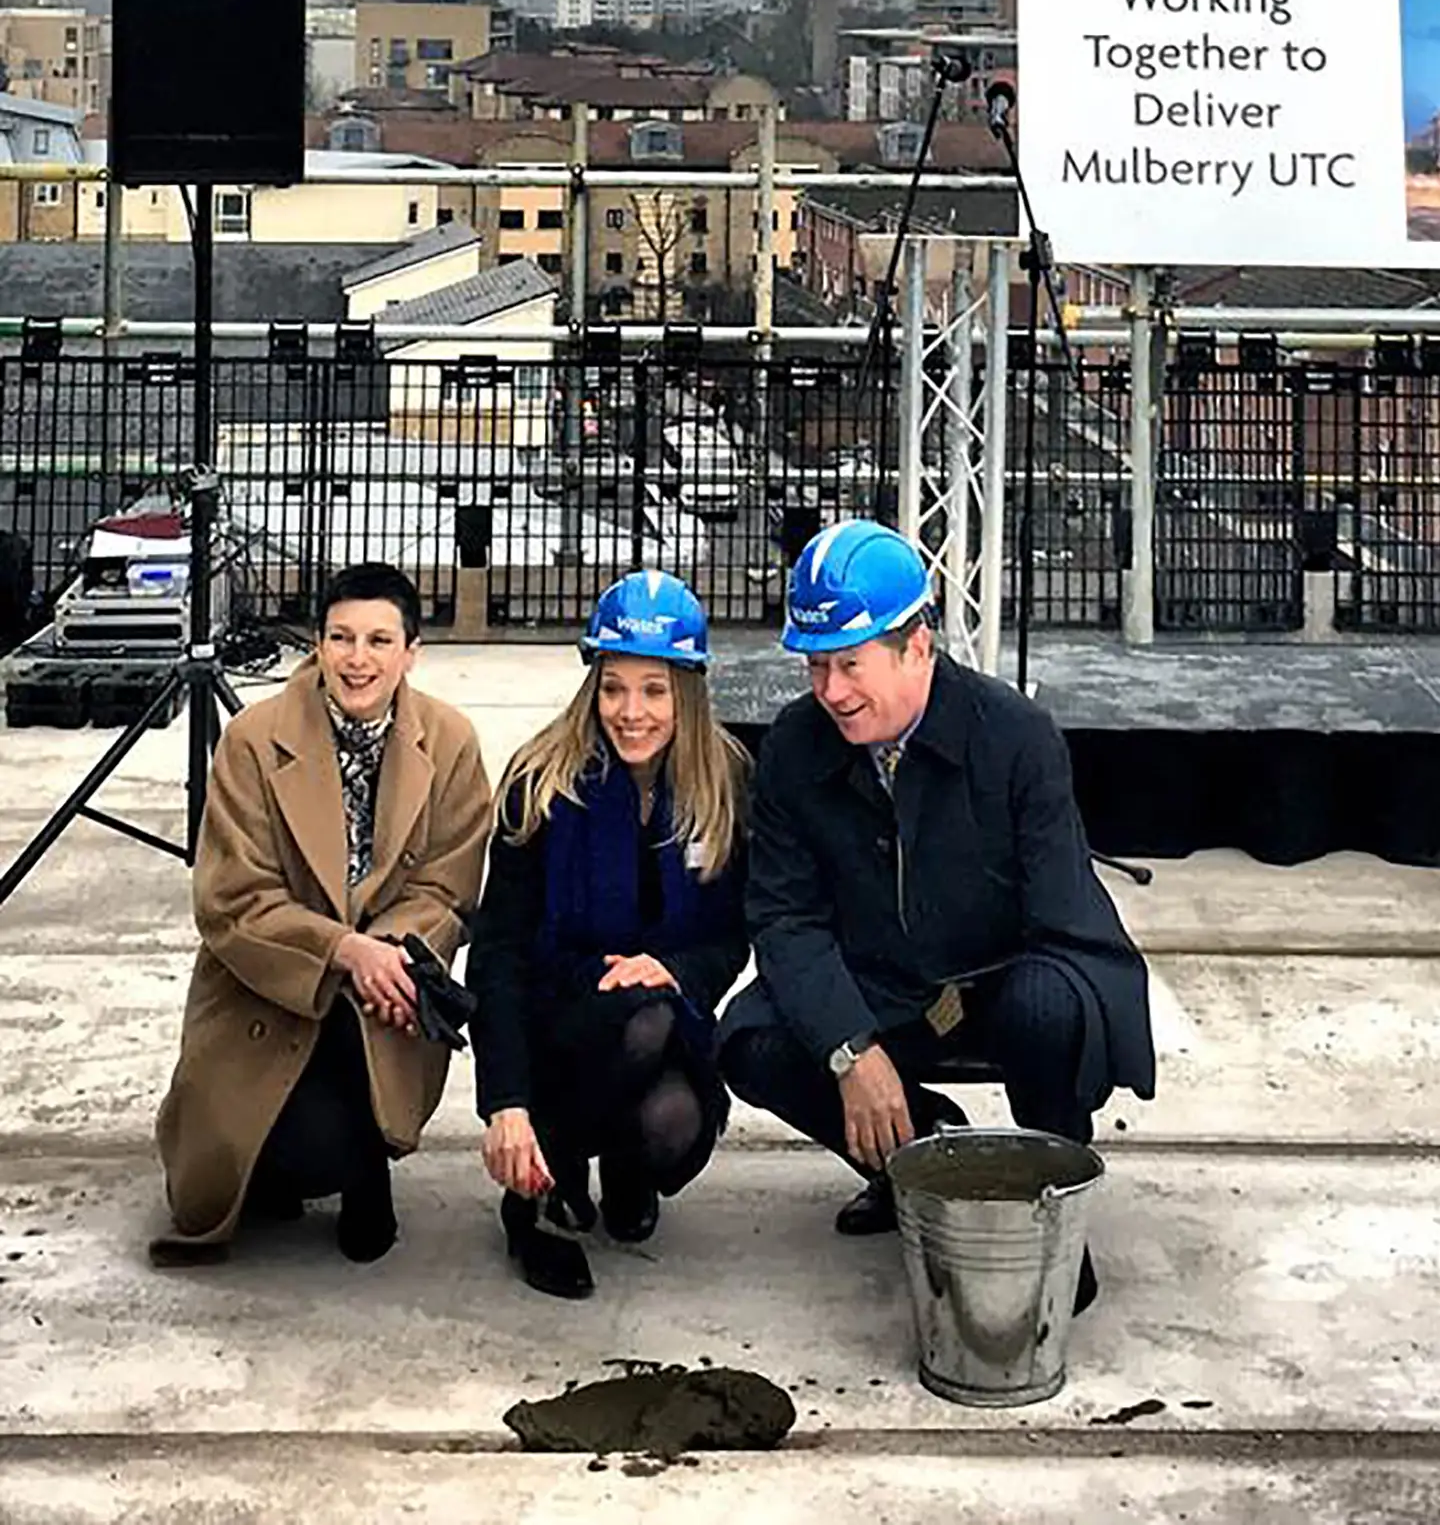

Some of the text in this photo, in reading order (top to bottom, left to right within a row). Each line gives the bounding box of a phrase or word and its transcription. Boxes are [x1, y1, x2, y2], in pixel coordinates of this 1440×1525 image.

[1083, 33, 1326, 80] Together to
[1134, 89, 1281, 128] Deliver
[1062, 146, 1355, 196] Mulberry UTC
